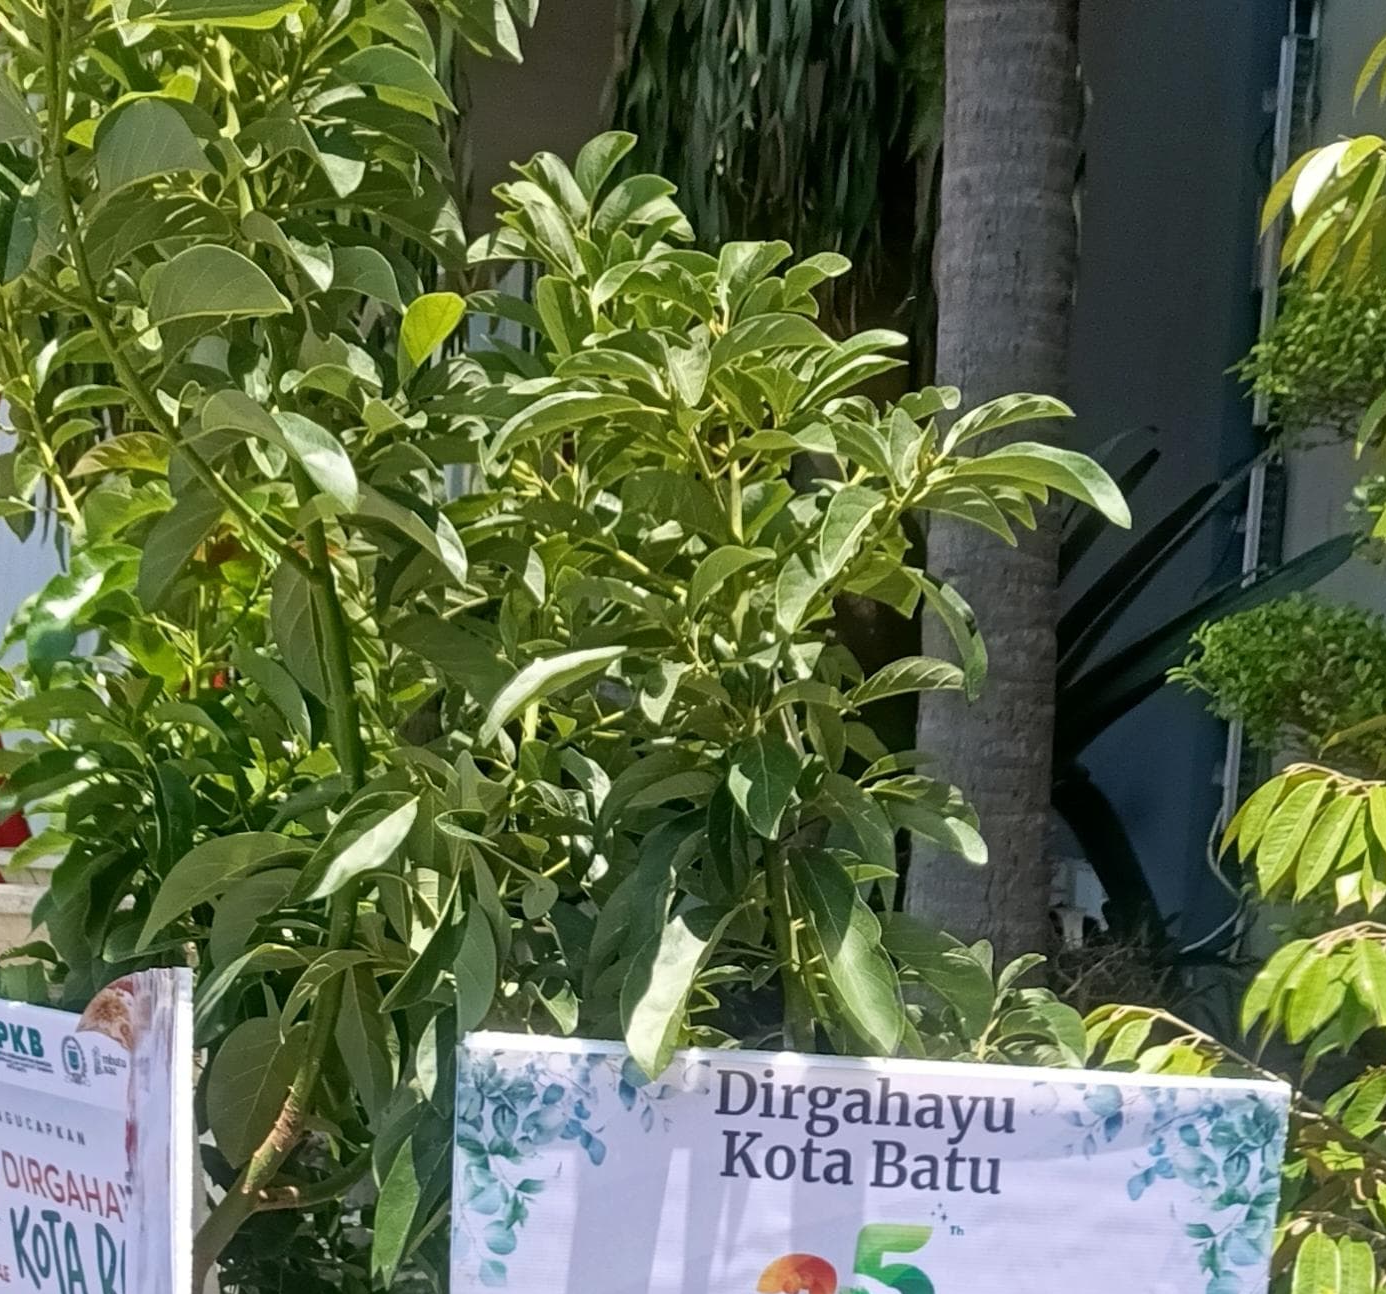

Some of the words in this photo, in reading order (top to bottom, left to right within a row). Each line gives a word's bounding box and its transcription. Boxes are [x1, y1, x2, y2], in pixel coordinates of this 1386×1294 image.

[714, 1068, 1016, 1146] Dirgahayu
[720, 1130, 854, 1186] Kota
[870, 1140, 1002, 1195] Batu
